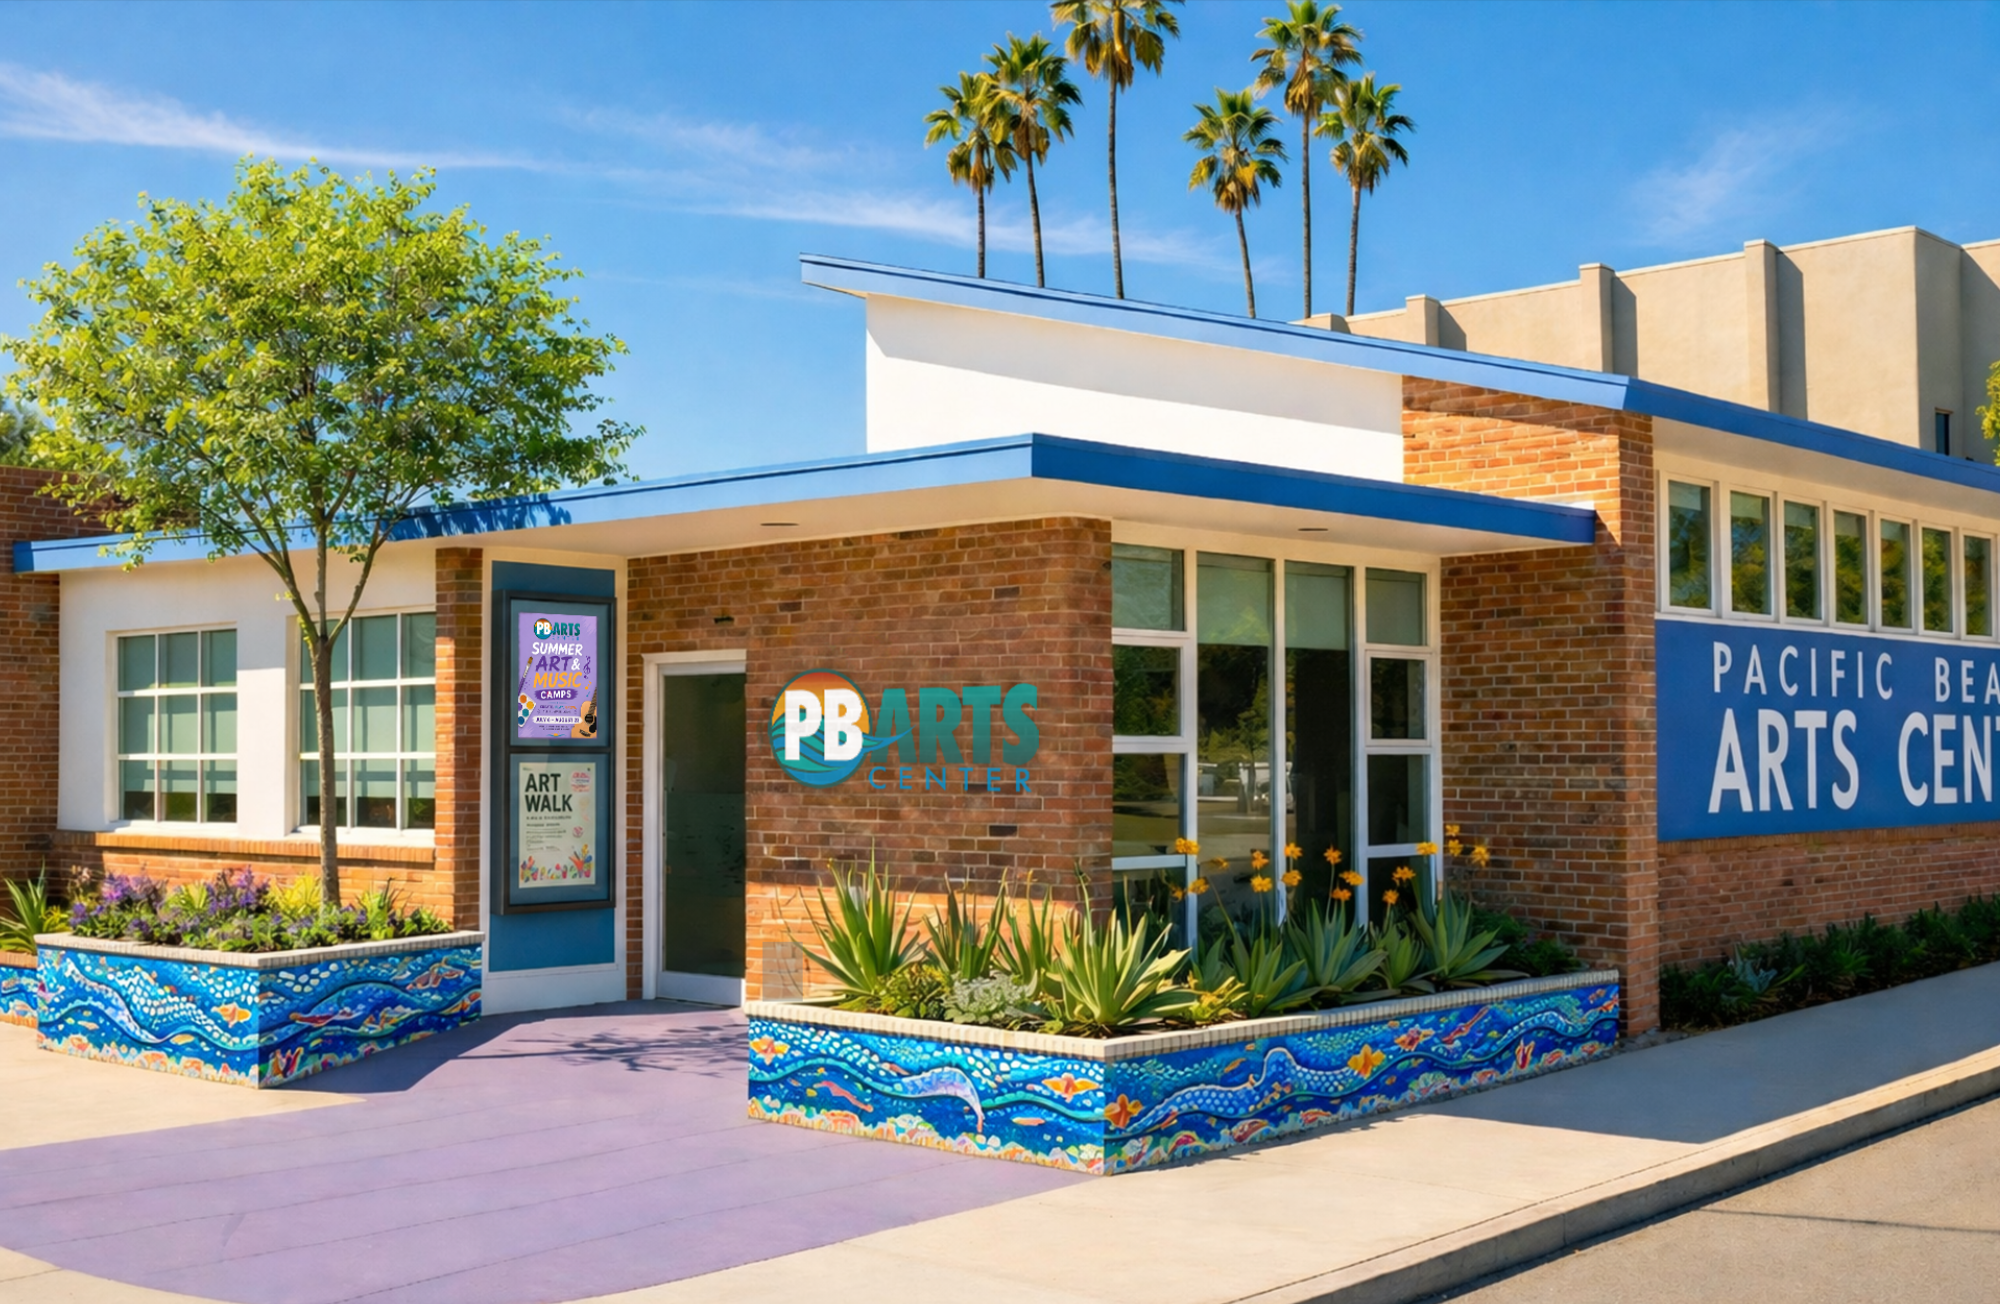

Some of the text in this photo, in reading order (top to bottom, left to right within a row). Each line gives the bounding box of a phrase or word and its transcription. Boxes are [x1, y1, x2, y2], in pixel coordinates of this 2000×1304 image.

[536, 621, 581, 637] PB ARTS
[532, 641, 583, 656] SUMMER
[535, 655, 581, 672] ART &
[1713, 641, 2000, 705] PACIFIC BEA
[533, 672, 583, 689] MUSIC
[540, 689, 572, 700] CAMPS
[785, 683, 1040, 766] PB ARTS
[1708, 707, 2000, 813] ARTS CEN
[525, 773, 561, 793] ART
[868, 766, 1031, 793] CENTER
[525, 794, 573, 813] WALK
